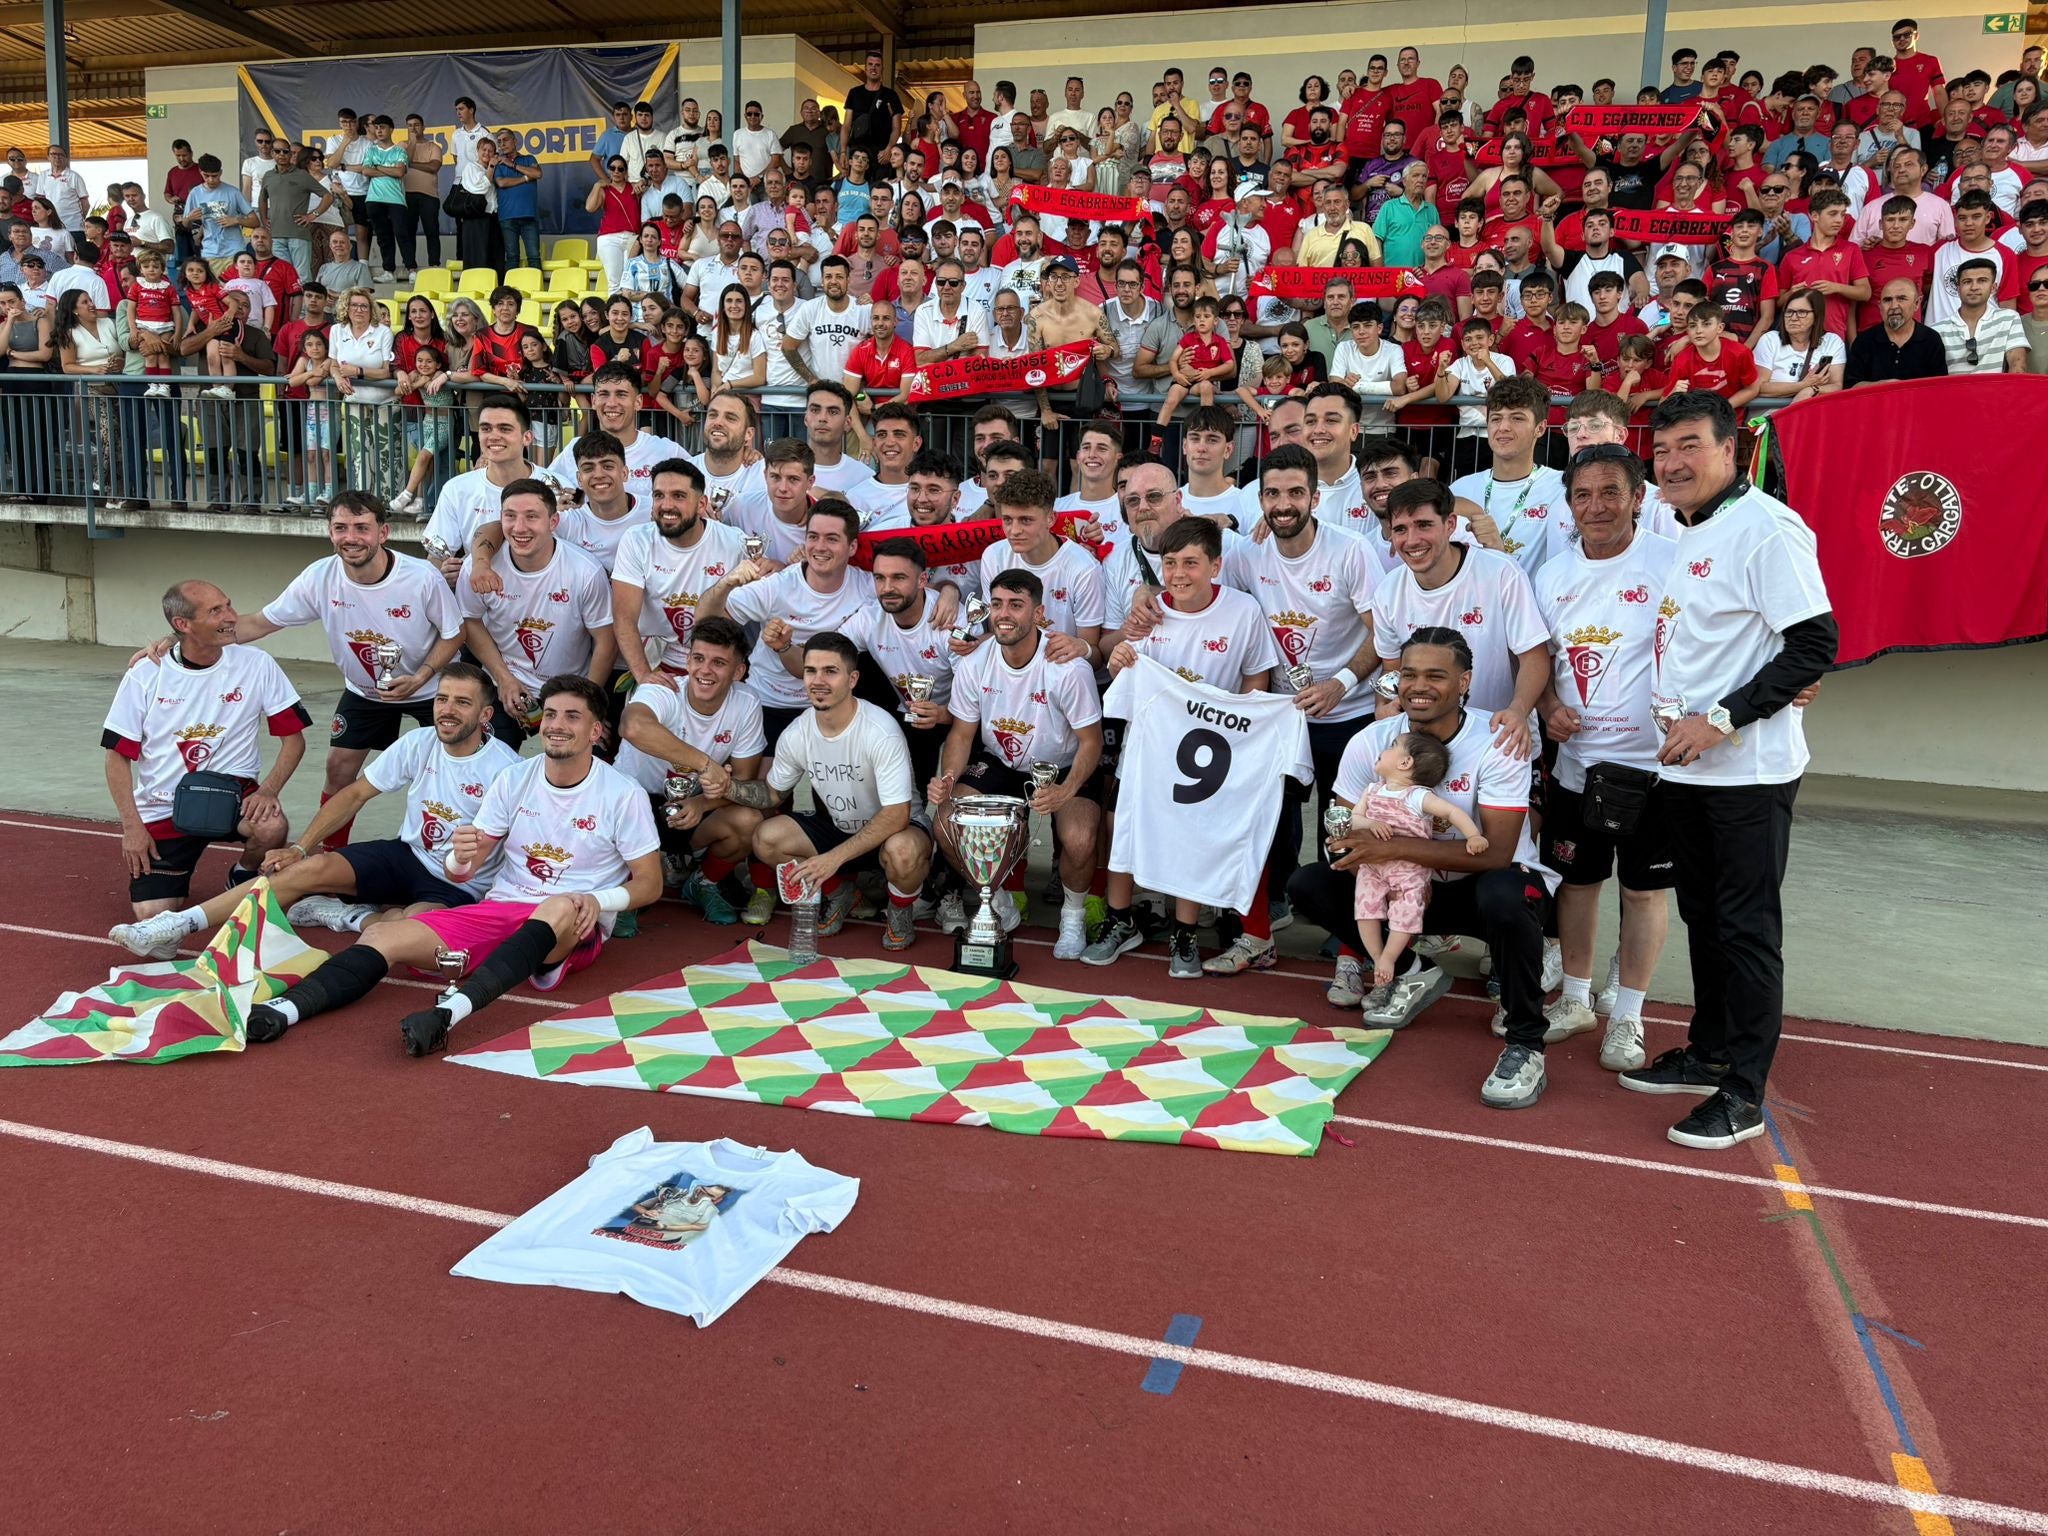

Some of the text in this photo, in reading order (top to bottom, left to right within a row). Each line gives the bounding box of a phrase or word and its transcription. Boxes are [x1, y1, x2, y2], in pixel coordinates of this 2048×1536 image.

[1571, 112, 1687, 127] C.D. EGABRENSE
[1032, 189, 1133, 210] C.D. EGABRENSE
[1616, 216, 1730, 236] C.D. EGABRENS
[1281, 271, 1304, 285] C.D.
[815, 324, 860, 338] SILBON
[932, 354, 1048, 380] C.D. EGABRENSE
[1919, 473, 1960, 551] GARGALLO
[1187, 700, 1252, 732] VÍCTOR
[1173, 727, 1232, 804] 9
[826, 794, 857, 812] CON
[623, 1225, 665, 1239] NUNCA
